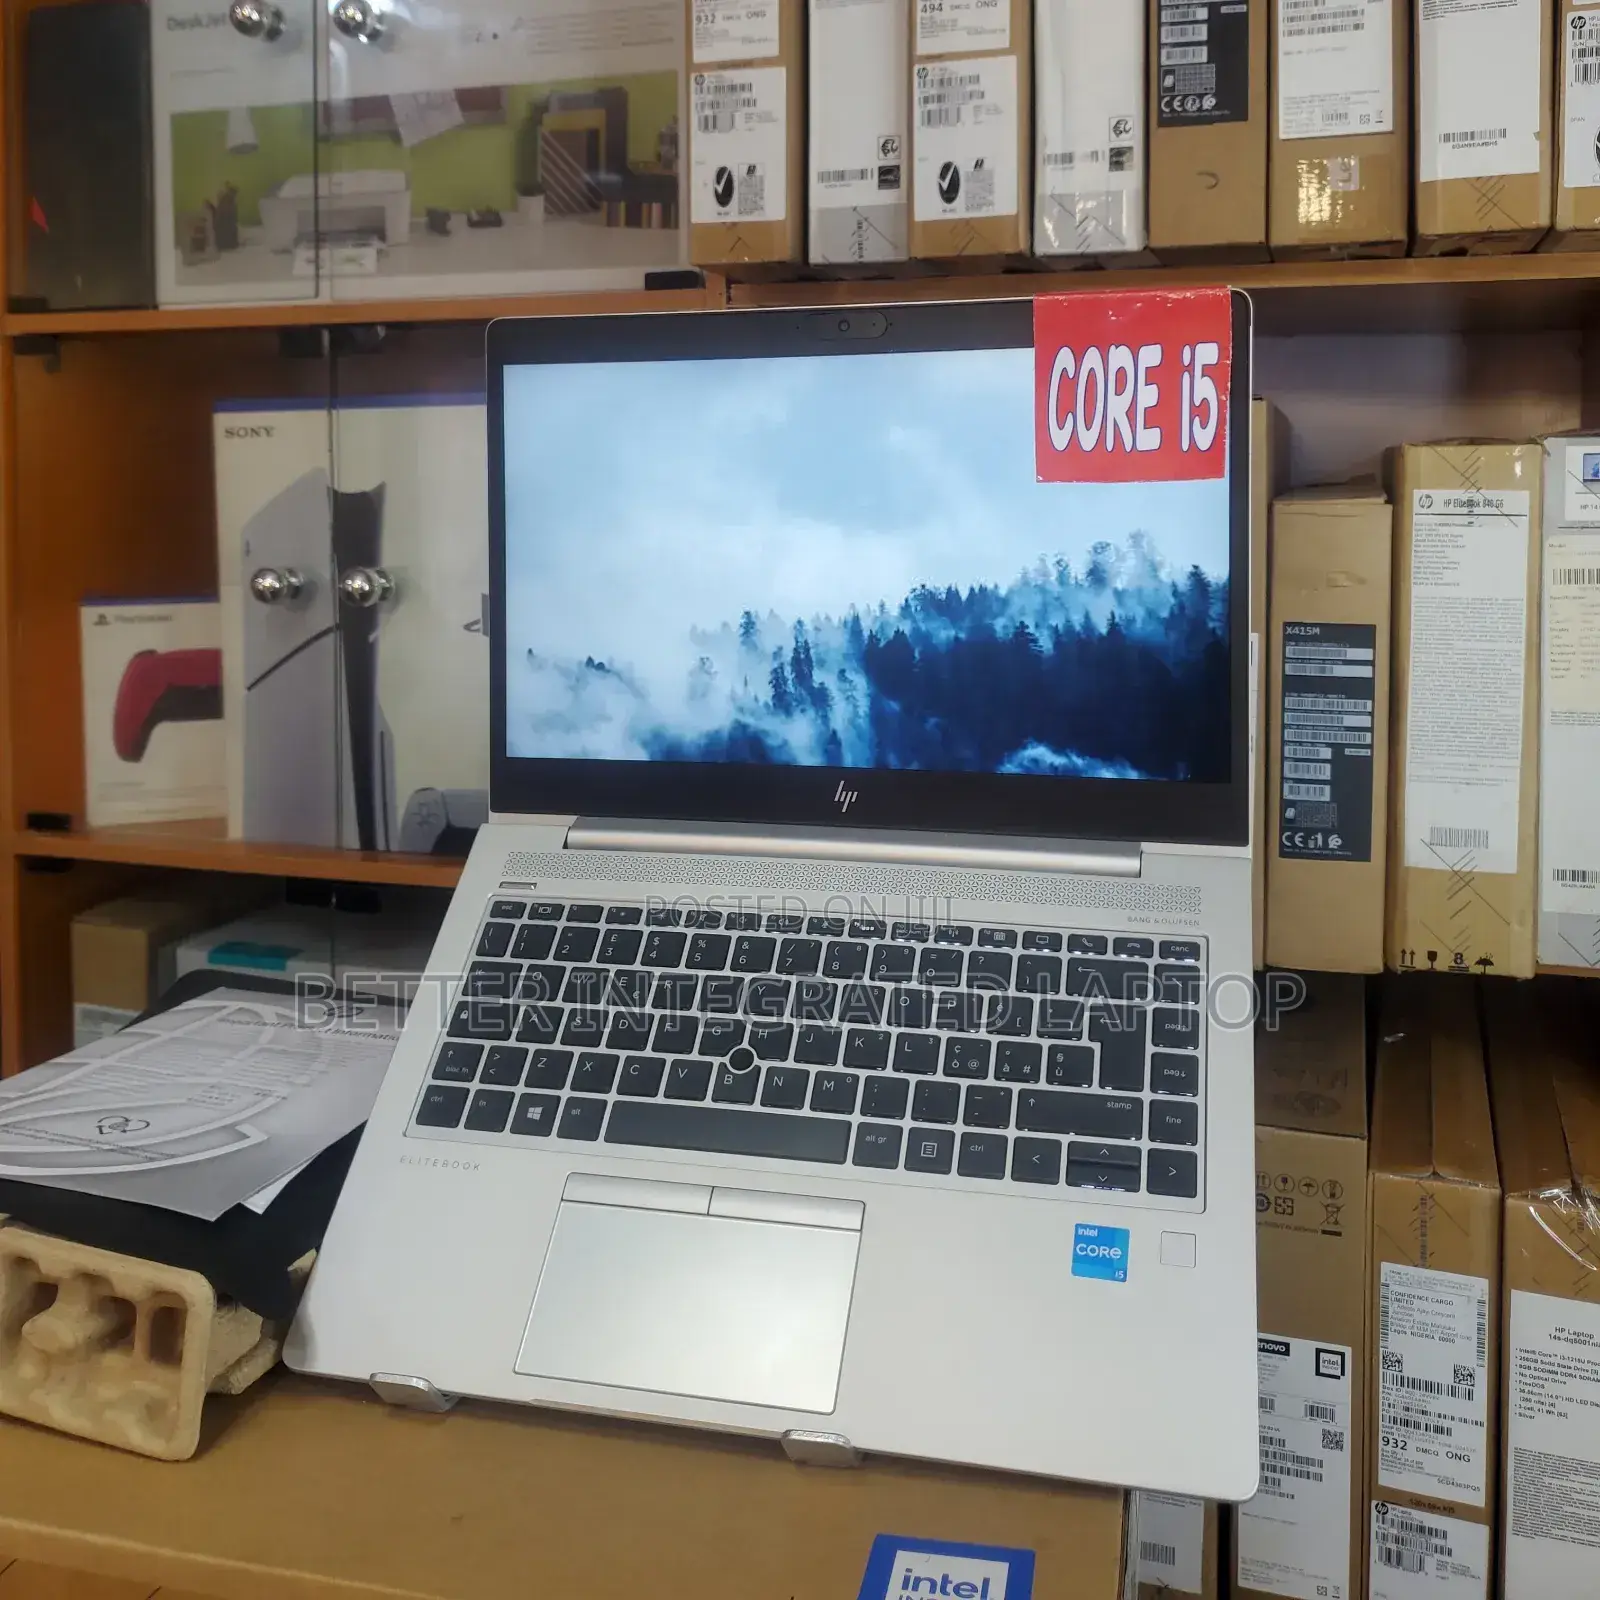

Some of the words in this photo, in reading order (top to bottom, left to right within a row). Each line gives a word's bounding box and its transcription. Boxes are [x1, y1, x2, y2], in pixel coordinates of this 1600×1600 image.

[921, 3, 943, 13] 494
[695, 13, 716, 25] 932
[1048, 343, 1163, 452] CORE
[1181, 342, 1219, 452] i5
[224, 427, 276, 439] SONY
[1443, 499, 1451, 508] HP
[1286, 626, 1320, 635] X415M
[833, 780, 859, 813] hp
[1161, 918, 1200, 926] OLUFSEN
[610, 934, 618, 942] £
[653, 937, 660, 946] $
[520, 943, 524, 951] 1
[697, 939, 706, 948] %
[562, 945, 570, 954] 2
[605, 948, 613, 956] 3
[649, 951, 657, 959] 4
[694, 952, 701, 961] 5
[739, 955, 747, 964] 6
[785, 958, 792, 967] 7
[832, 961, 839, 970] 8
[879, 965, 887, 974] 9
[619, 977, 628, 986] E
[757, 986, 766, 996] Y
[804, 989, 812, 999] U
[529, 1014, 539, 1022] A
[574, 1017, 582, 1025] S
[618, 1020, 628, 1029] D
[664, 1023, 673, 1032] F
[712, 1026, 721, 1035] G
[758, 1029, 767, 1039] H
[805, 1034, 814, 1043] J
[855, 1037, 864, 1047] K
[905, 1042, 912, 1052] L
[537, 1058, 547, 1067] Z
[582, 1061, 593, 1071] X
[968, 1059, 979, 1069] @
[630, 1065, 639, 1074] C
[678, 1068, 687, 1078] V
[1023, 1065, 1031, 1074] #
[724, 1075, 733, 1084] B
[773, 1076, 783, 1086] N
[823, 1080, 834, 1091] M
[1106, 1101, 1132, 1110] stamp
[1166, 1116, 1181, 1124] fine
[878, 1136, 886, 1144] gr
[400, 1155, 480, 1171] ELITEBOOK
[1078, 1227, 1098, 1236] intel
[1115, 1270, 1124, 1278] i5
[1390, 1290, 1429, 1303] CONFIDENCE
[1431, 1298, 1454, 1306] CARGO
[1390, 1297, 1414, 1306] LIMITED
[1568, 1329, 1595, 1340] Laptop
[1540, 1359, 1556, 1367] Solid
[1574, 1365, 1590, 1373] Drive
[1529, 1373, 1550, 1382] Optical
[1551, 1377, 1567, 1385] Drive
[1519, 1380, 1546, 1389] FreeDOS
[1518, 1412, 1535, 1420] Silver
[1382, 1436, 1408, 1451] 932
[1416, 1447, 1439, 1457] DMCQ
[1446, 1451, 1471, 1463] ONG
[1375, 1502, 1389, 1515] hp
[901, 1568, 993, 1600] intel
